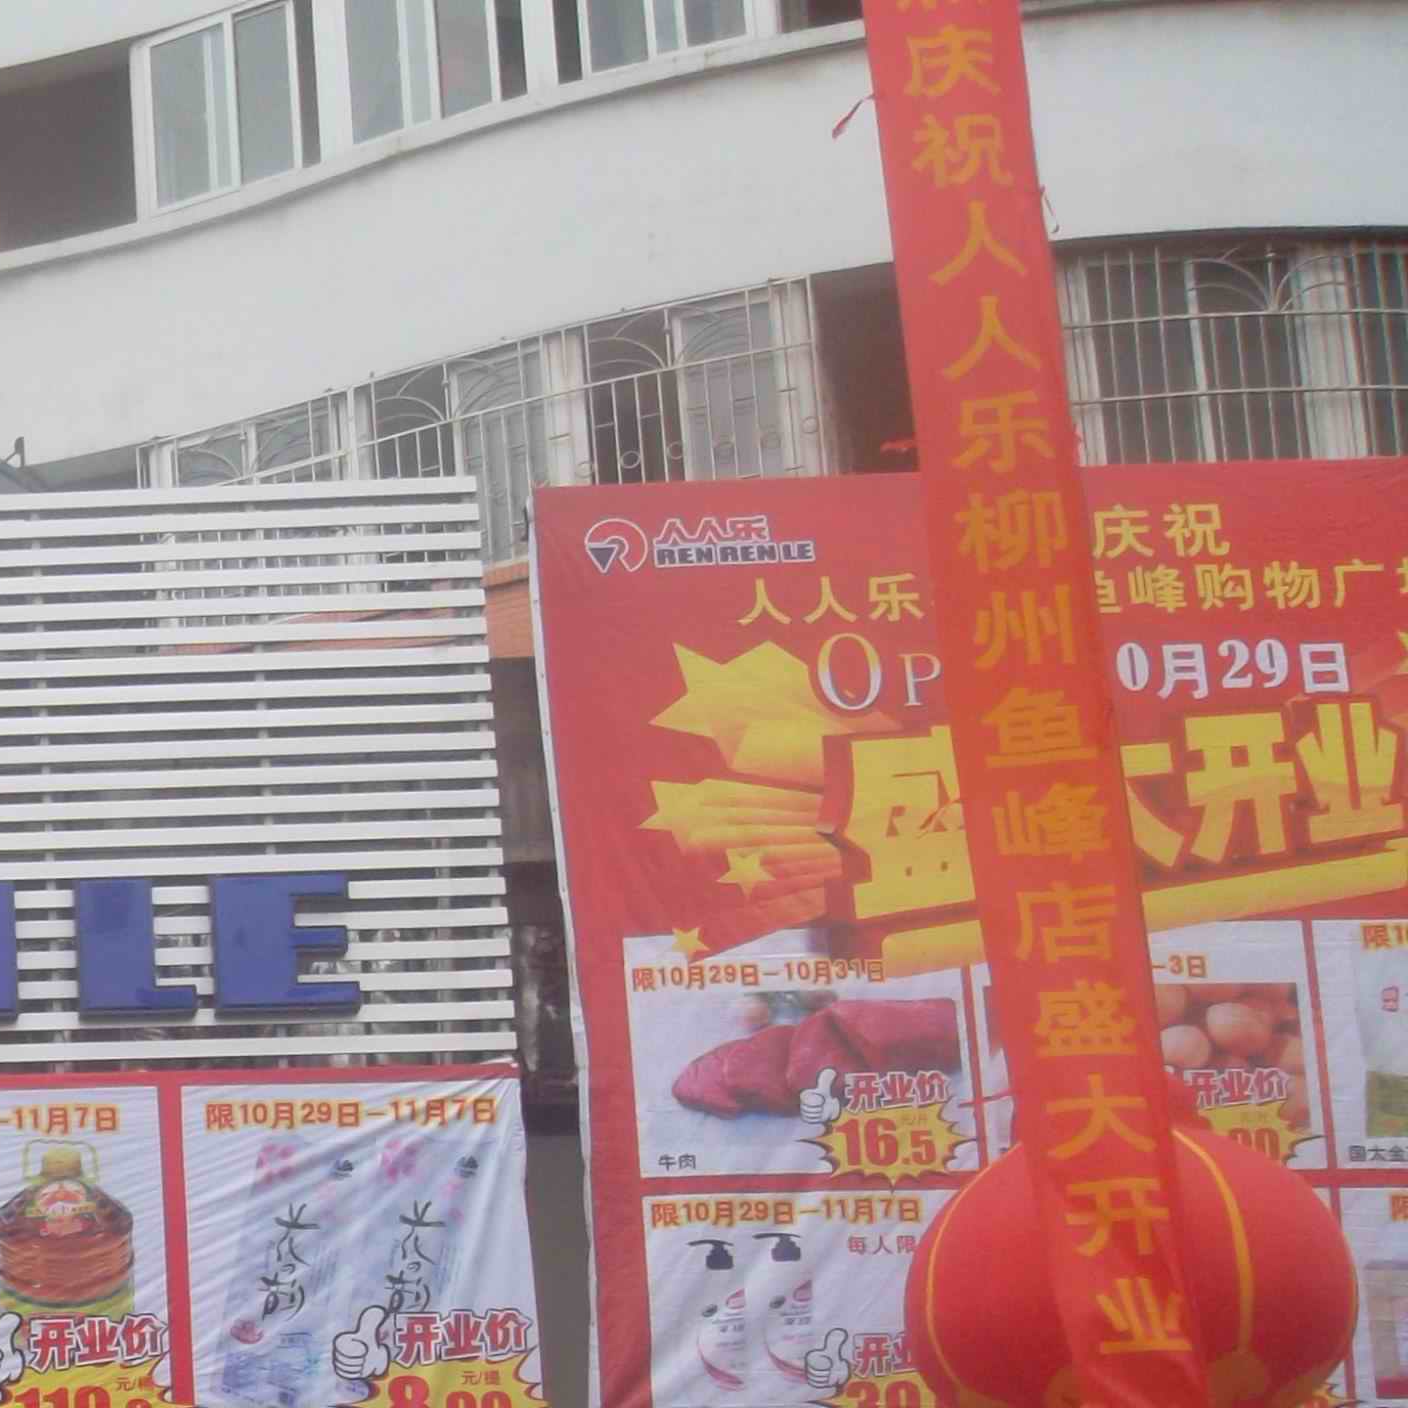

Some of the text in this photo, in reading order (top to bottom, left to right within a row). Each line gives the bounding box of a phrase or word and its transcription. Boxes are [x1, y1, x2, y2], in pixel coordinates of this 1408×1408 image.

[654, 515, 770, 544] 人人乐
[899, 0, 1193, 1355] 庆祝人人乐柳州鱼峰店盛大开业
[74, 873, 362, 1021] LE
[846, 1070, 950, 1114] 开业价
[657, 1154, 697, 1173] 牛肉
[834, 1118, 937, 1167] 16.5
[27, 1315, 167, 1374] 开业价
[396, 1309, 532, 1368] 开业价
